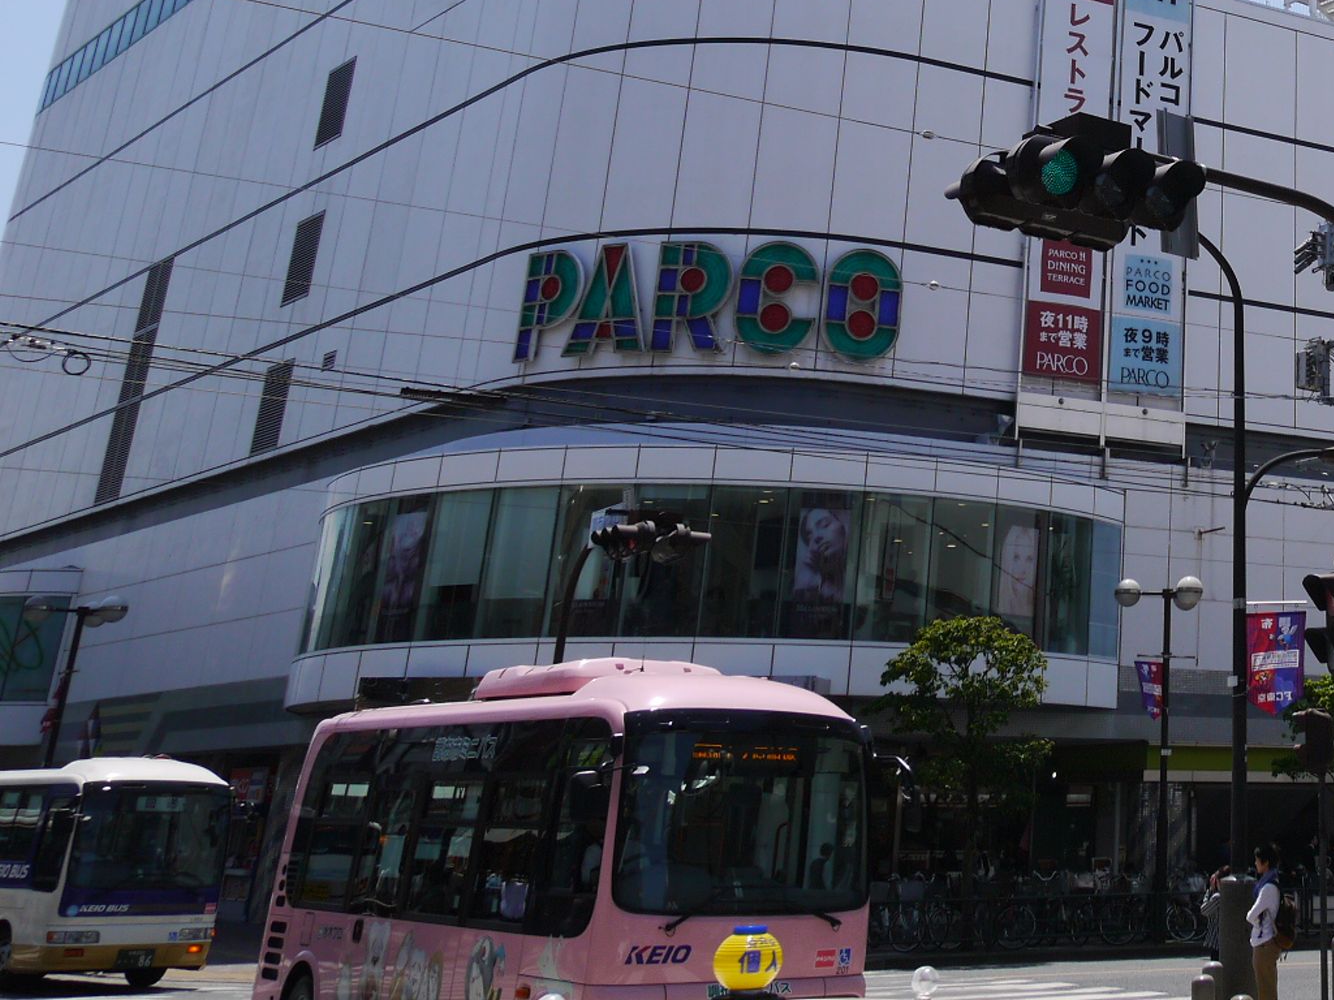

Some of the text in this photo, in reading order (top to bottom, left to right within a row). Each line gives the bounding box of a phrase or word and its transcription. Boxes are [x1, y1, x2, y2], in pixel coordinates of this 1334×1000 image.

[1064, 3, 1090, 113] レストラ
[1159, 31, 1184, 106] パルコ
[1128, 21, 1155, 246] フードマート
[1048, 249, 1077, 262] PARCO
[1047, 260, 1086, 275] DINING
[1126, 266, 1171, 282] PARCO
[1047, 273, 1086, 286] TERRACE
[1125, 279, 1171, 296] FOOD
[512, 241, 903, 363] PARCO
[1125, 294, 1170, 311] MARKET
[1040, 311, 1088, 332] 夜11時
[1039, 331, 1088, 350] まで営業
[1123, 327, 1170, 348] 夜9時
[1036, 352, 1088, 376] PARCO
[1123, 345, 1169, 364] まで営業
[1120, 367, 1170, 389] PARCO
[8, 863, 31, 879] BUS
[80, 904, 130, 913] KEIO BUS
[625, 945, 692, 965] KEIO
[737, 950, 778, 974] 個人
